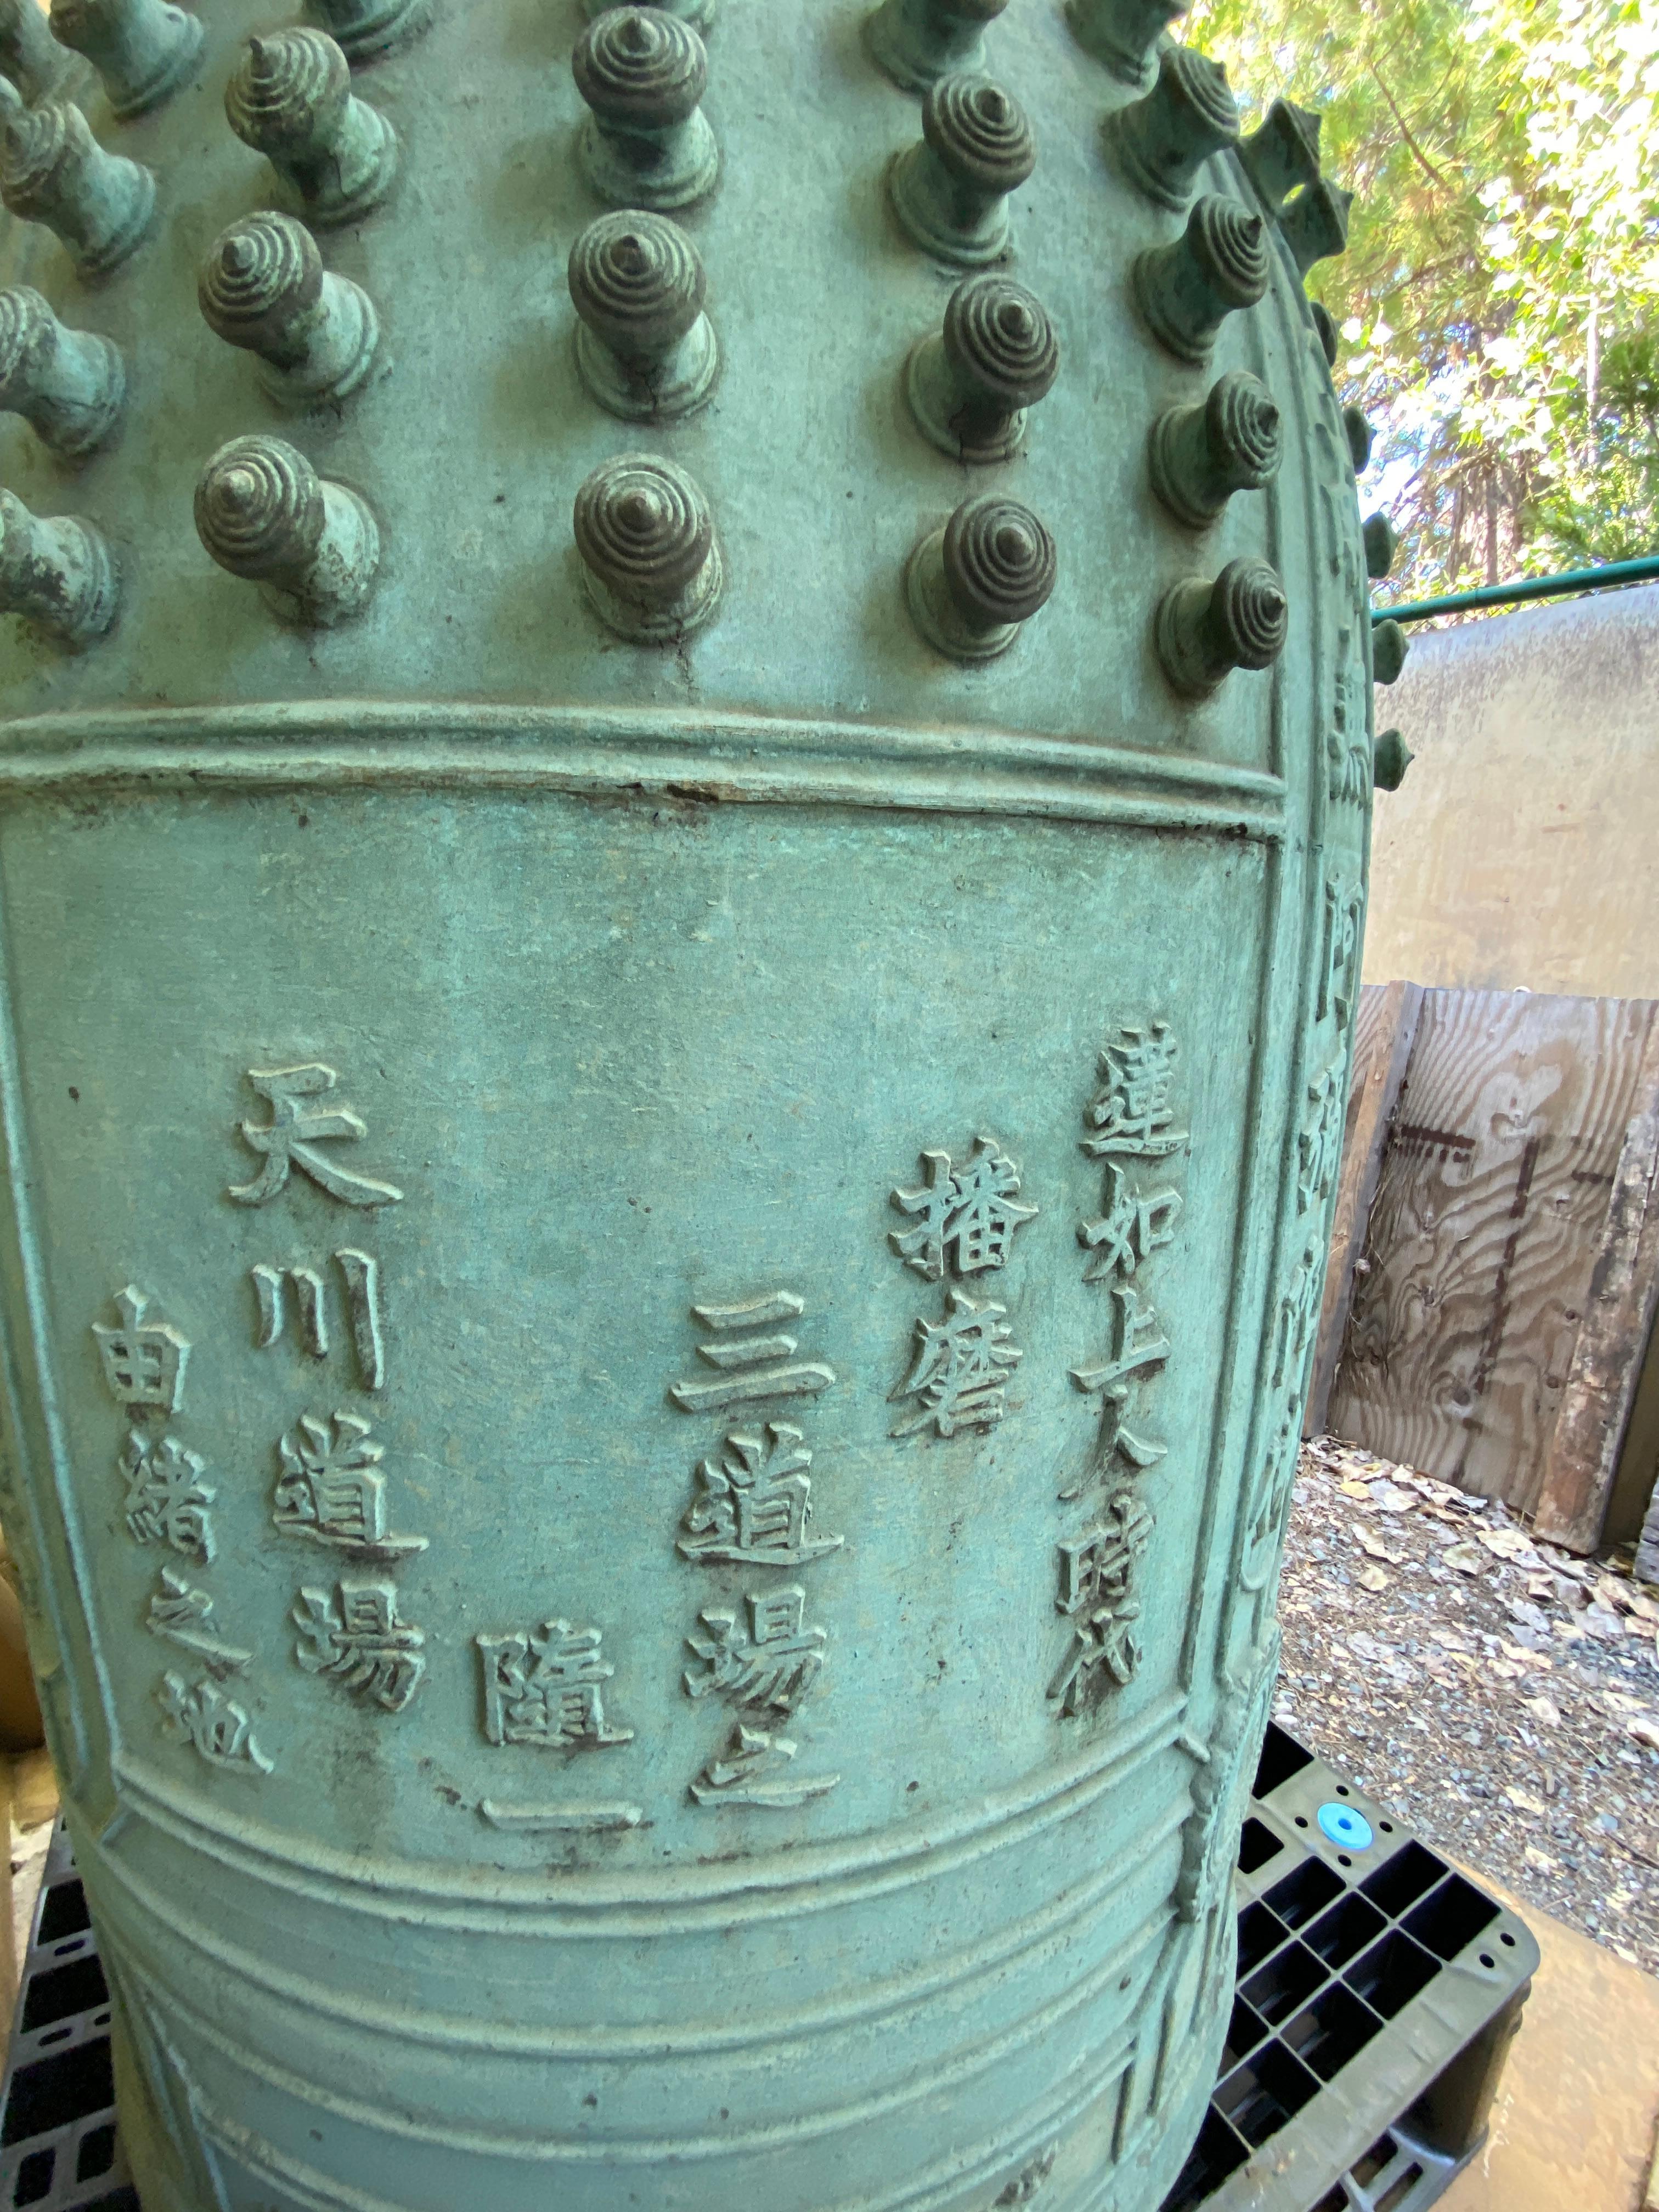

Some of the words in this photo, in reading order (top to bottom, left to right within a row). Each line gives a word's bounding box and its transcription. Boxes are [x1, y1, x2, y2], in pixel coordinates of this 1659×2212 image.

[227, 1062, 430, 1713] 天川道場
[887, 1136, 1040, 1438] 播磨
[669, 1290, 844, 1807] 三道場之
